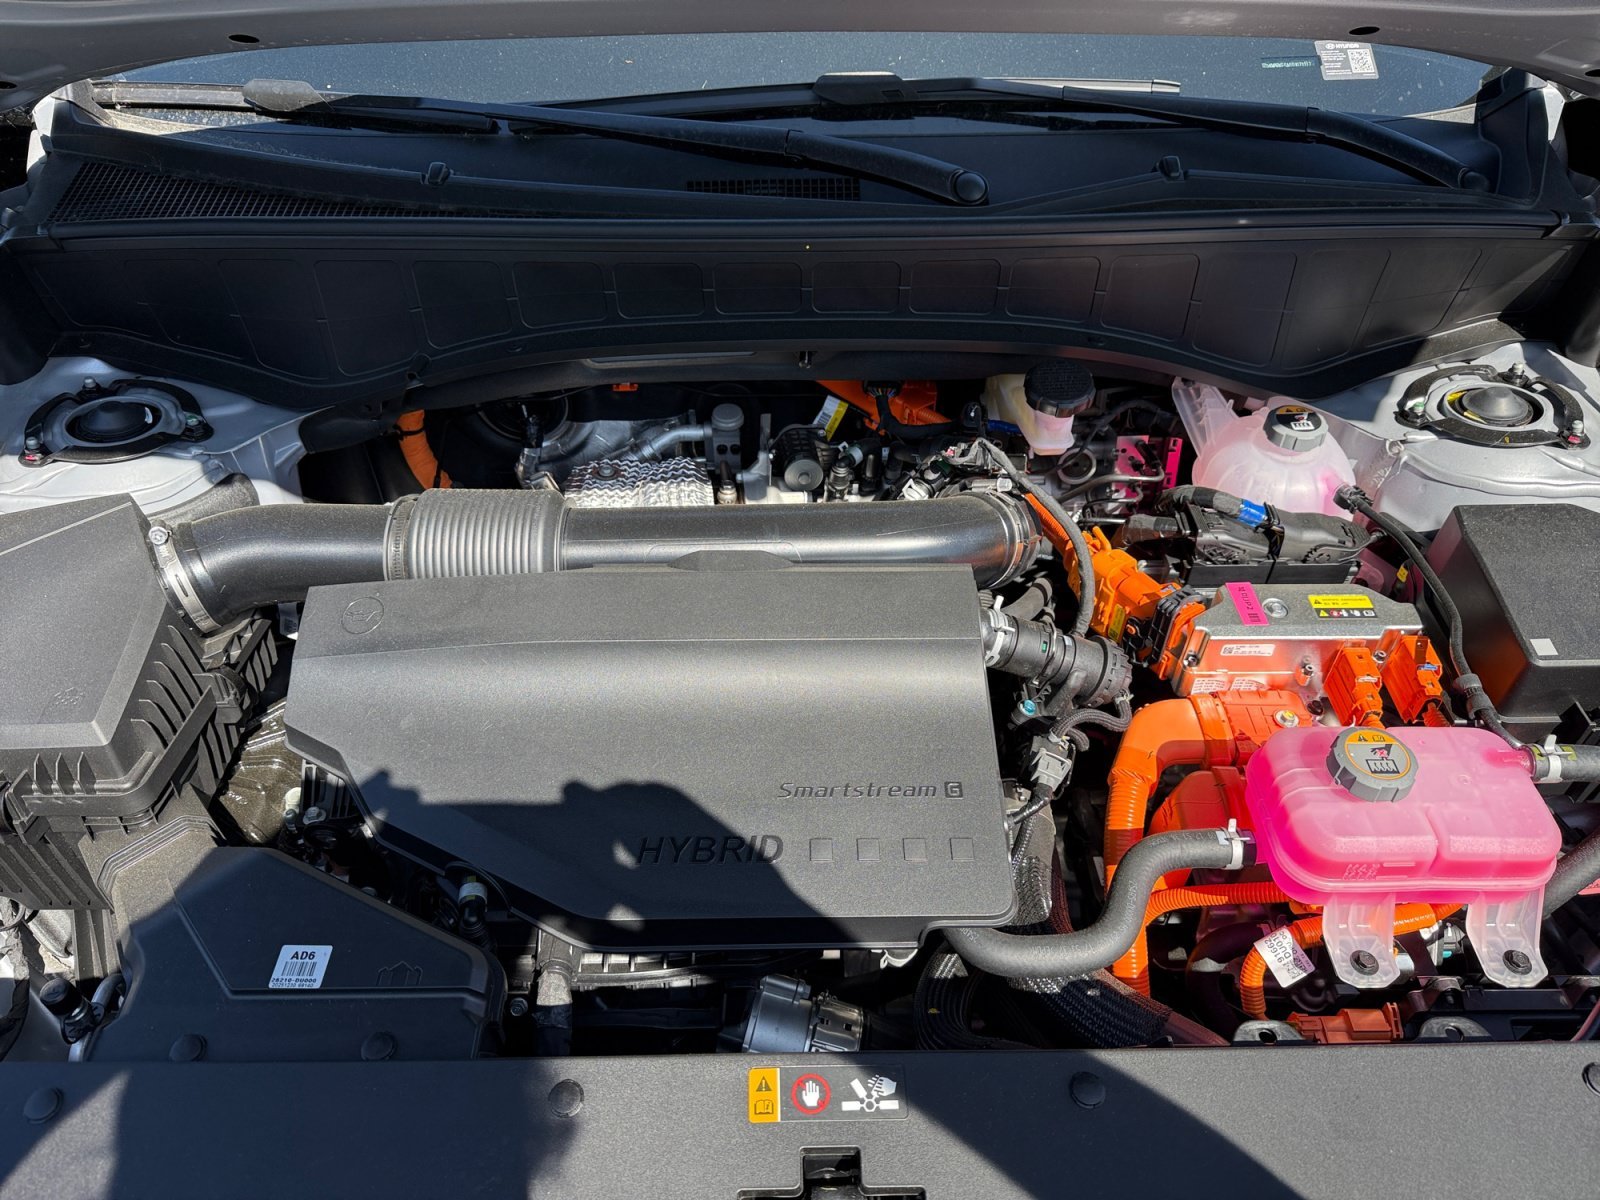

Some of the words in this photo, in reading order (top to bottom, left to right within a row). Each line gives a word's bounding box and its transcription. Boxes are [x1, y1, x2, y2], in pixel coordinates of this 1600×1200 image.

[777, 782, 937, 799] Smartstream
[637, 834, 785, 865] HYBRID
[290, 950, 316, 961] AD6
[1264, 939, 1285, 963] 91662
